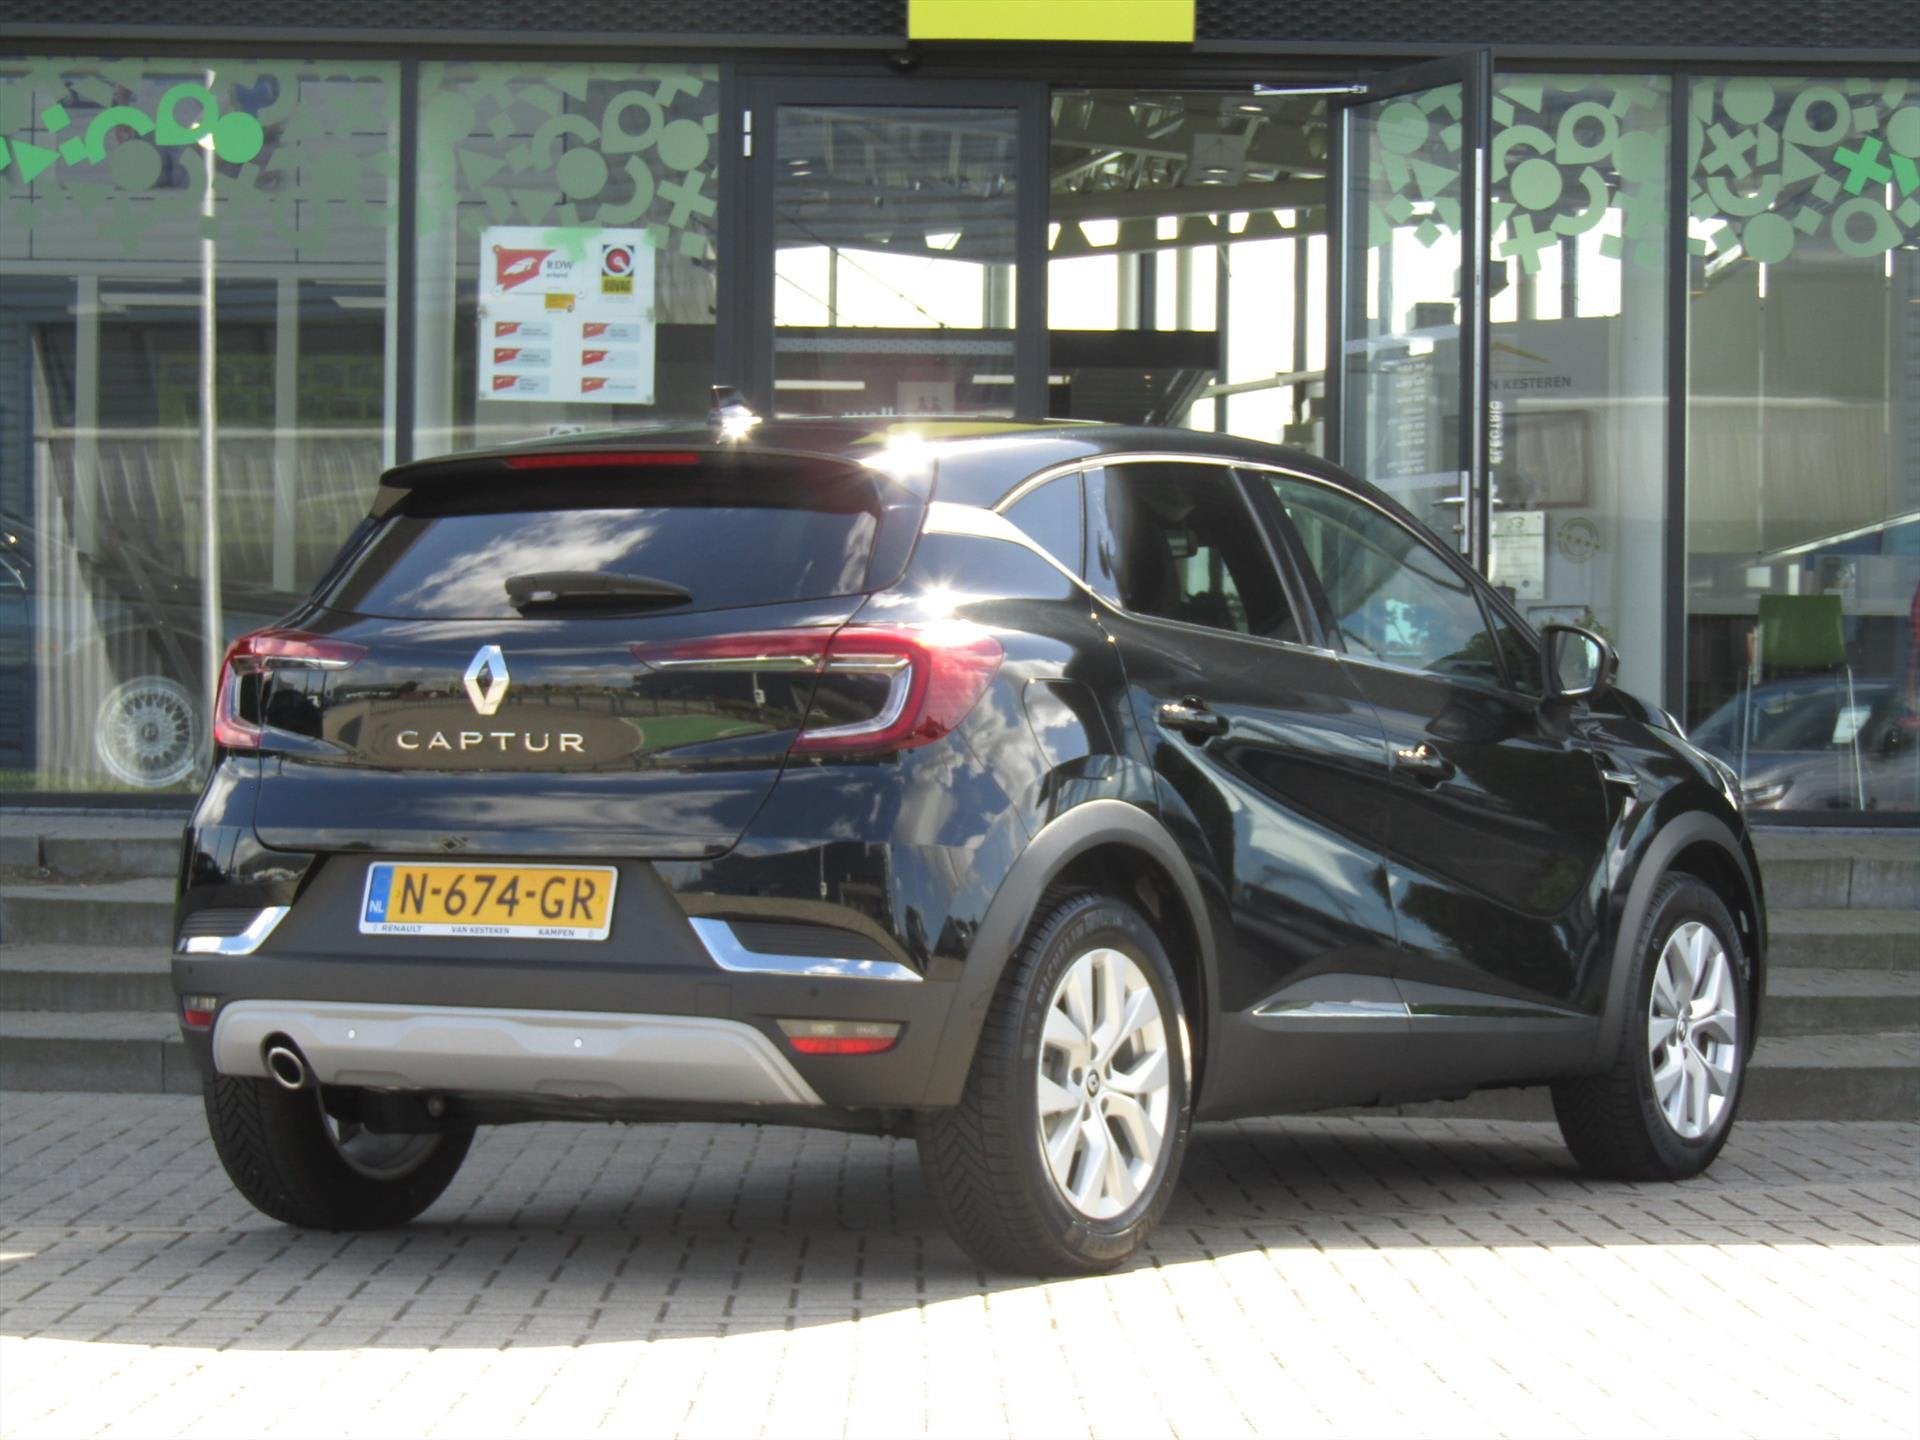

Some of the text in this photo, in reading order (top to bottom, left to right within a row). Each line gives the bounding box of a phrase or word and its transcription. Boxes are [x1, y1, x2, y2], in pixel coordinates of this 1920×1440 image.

[546, 259, 573, 270] RDW
[1503, 375, 1572, 390] KESTEREN
[396, 730, 585, 752] CAPTUR
[400, 873, 596, 920] N-674-GR
[369, 899, 384, 914] NL
[381, 924, 422, 933] RENAULT
[451, 926, 468, 934] VAN
[538, 928, 575, 937] KAMPEN
